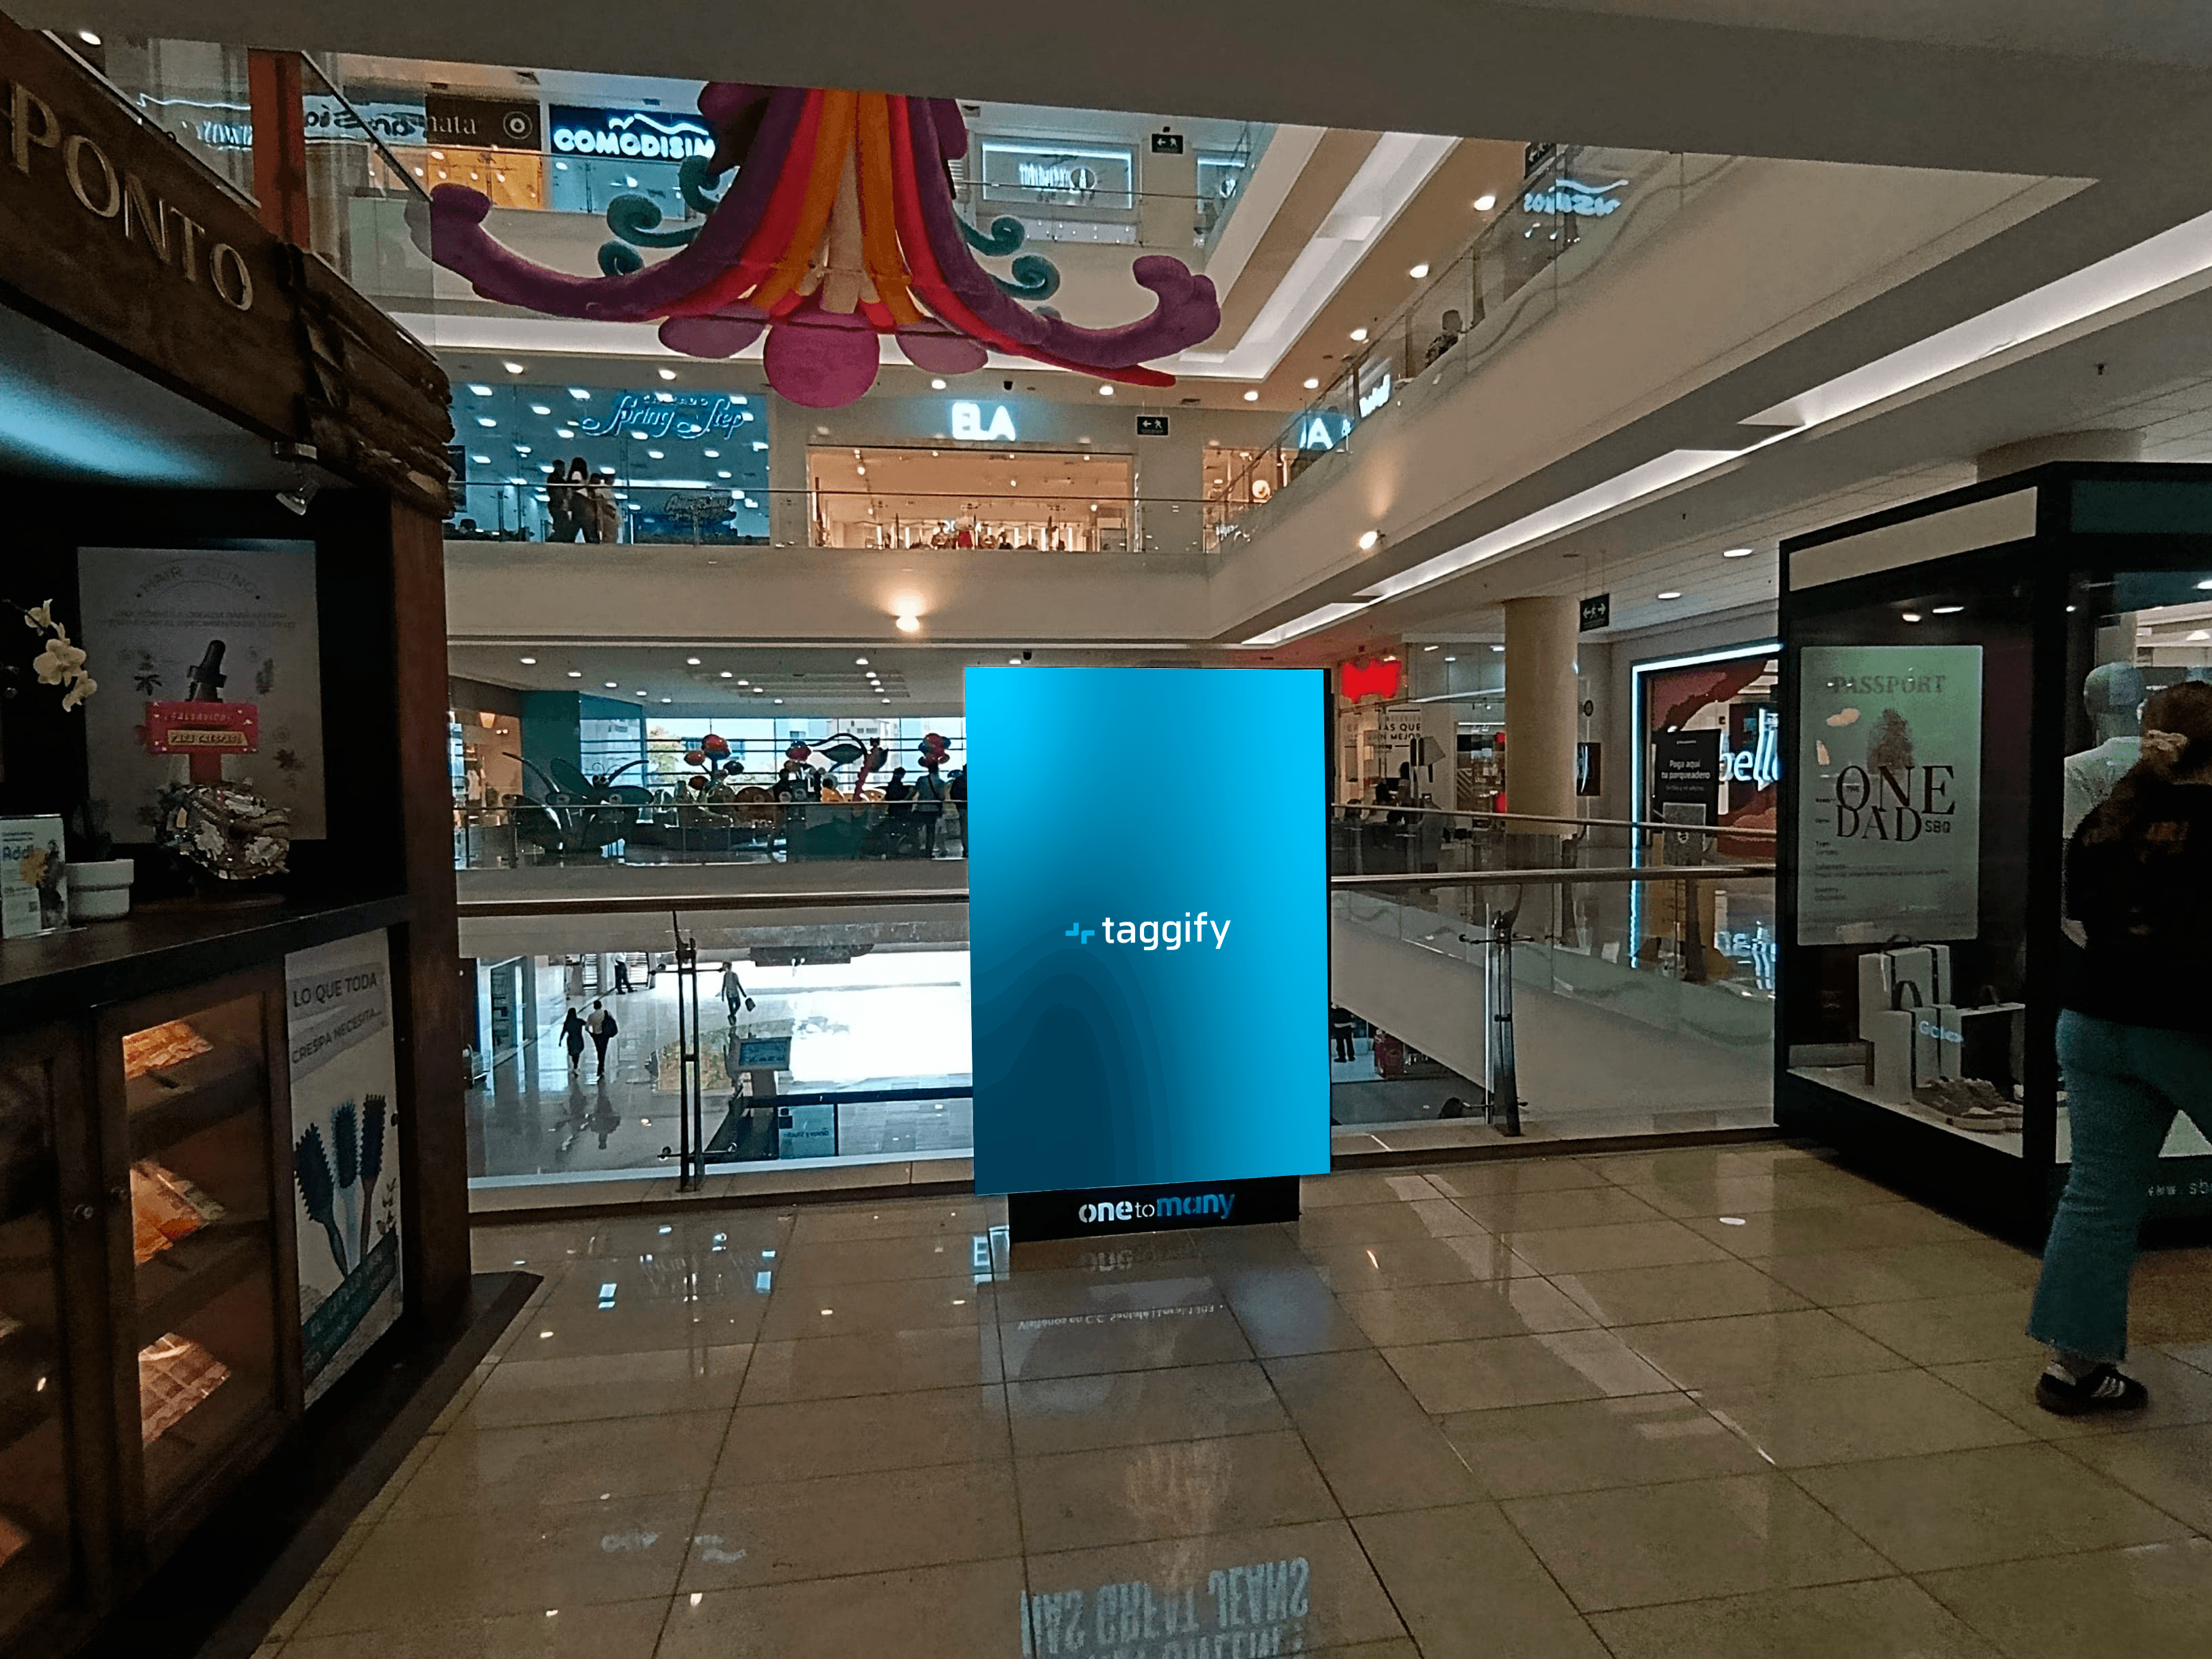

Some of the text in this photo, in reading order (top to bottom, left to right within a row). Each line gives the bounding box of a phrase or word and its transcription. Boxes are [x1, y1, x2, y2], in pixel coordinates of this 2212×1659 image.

[8, 79, 254, 312] PONTO
[581, 395, 745, 441] Spring Step
[1830, 674, 1946, 695] PASSPORT
[1399, 722, 1421, 732] QUE
[1835, 764, 1955, 815] ONE
[1835, 805, 1922, 842] DAD
[1103, 911, 1232, 951] taggify
[293, 971, 377, 1008] LO QUE TODA
[291, 1031, 332, 1063] CRESPA
